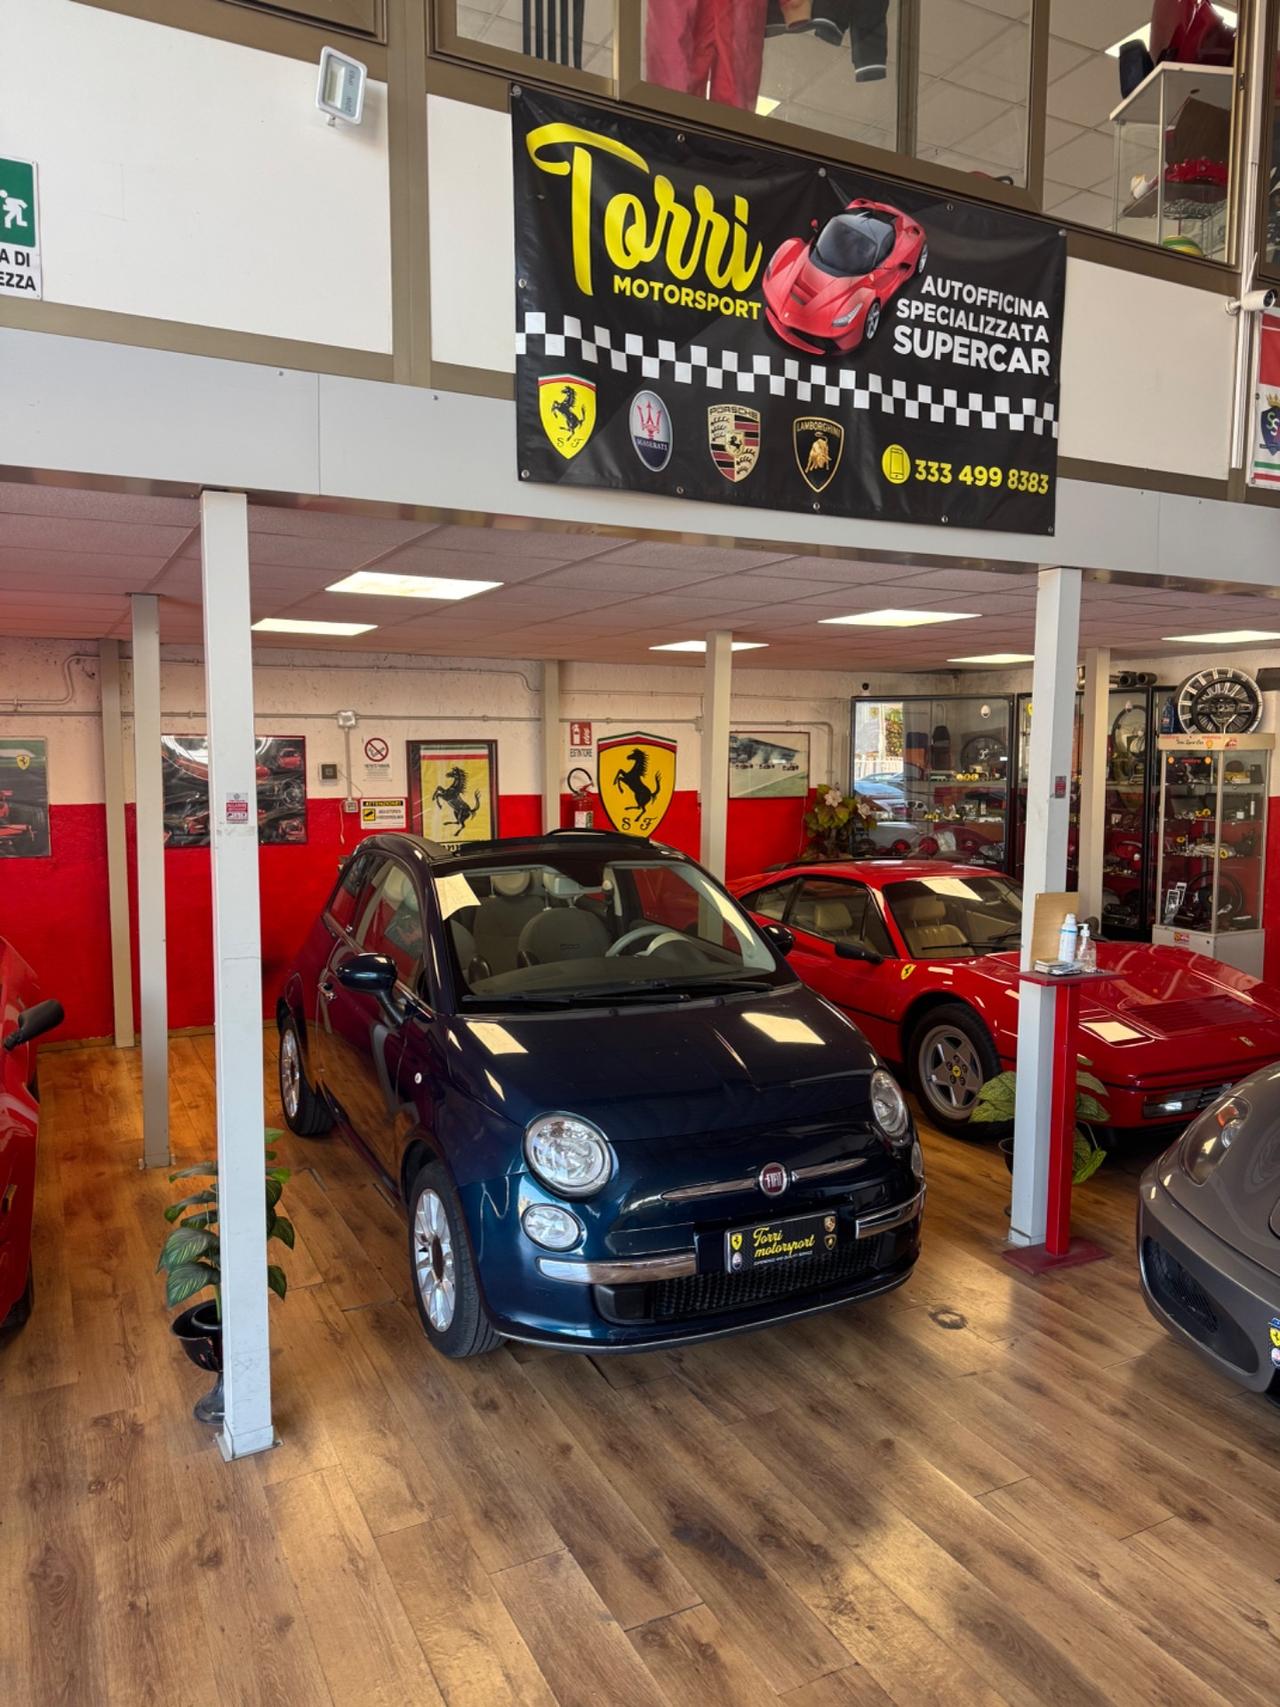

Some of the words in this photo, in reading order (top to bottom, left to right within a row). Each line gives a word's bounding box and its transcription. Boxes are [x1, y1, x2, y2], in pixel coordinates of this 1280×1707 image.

[526, 122, 763, 296] Torri
[14, 250, 30, 267] DI
[613, 275, 762, 320] MOTORSPORT
[920, 275, 1049, 319] AUTOFFICINA
[896, 298, 1049, 343] SPECIALIZZATA
[893, 325, 1050, 376] SUPERCAR
[710, 405, 758, 420] PORSCHE
[797, 420, 841, 438] LAMBORGHINI
[915, 459, 953, 485] 333
[958, 465, 1003, 488] 499
[1007, 468, 1049, 495] 8383
[753, 1227, 783, 1247] Torri
[754, 1234, 816, 1258] motorsport
